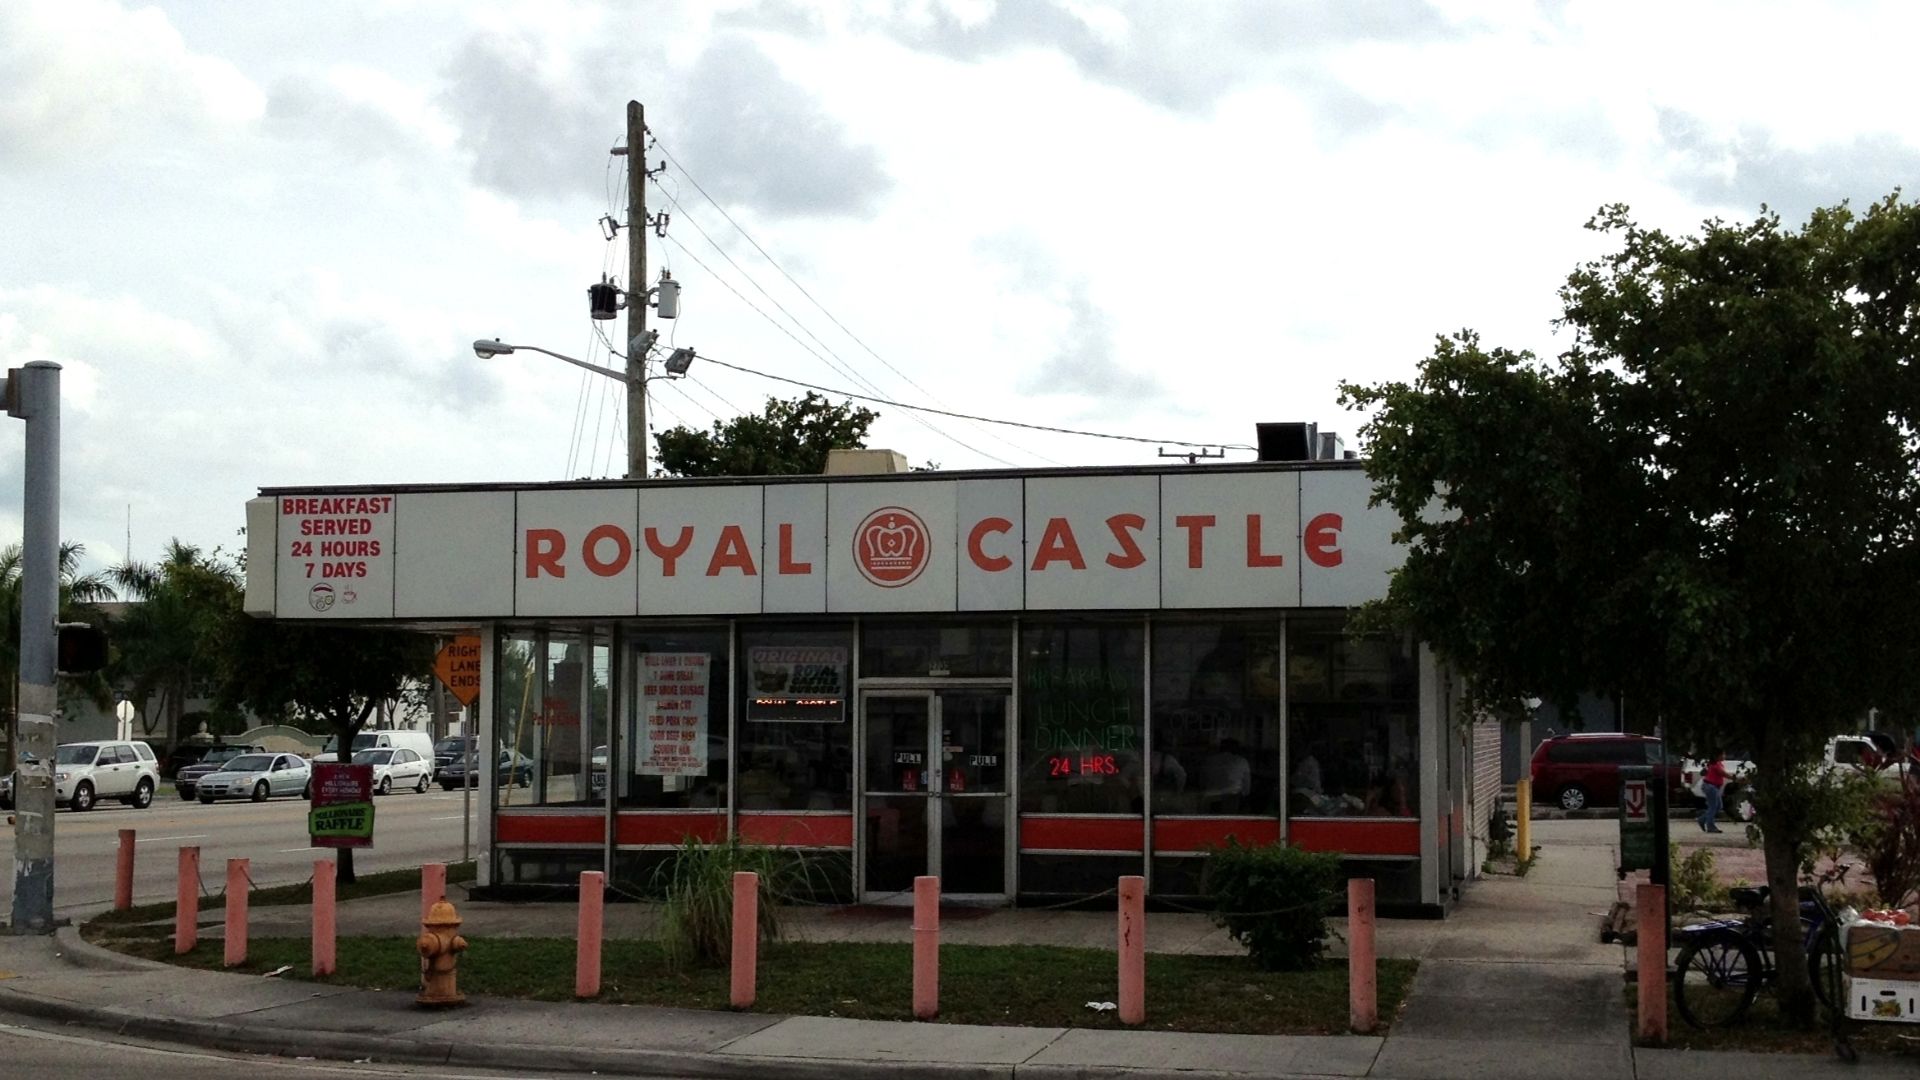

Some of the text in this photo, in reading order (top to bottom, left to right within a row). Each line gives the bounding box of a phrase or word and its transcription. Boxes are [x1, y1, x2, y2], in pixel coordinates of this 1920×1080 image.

[282, 497, 392, 515] BREAKFAST
[300, 518, 372, 535] SERVED
[291, 540, 381, 557] 24 HOURS
[526, 512, 1343, 578] ROYAL CASTLE
[304, 561, 367, 578] 7 DAYS
[793, 664, 839, 677] ROYAL
[1038, 695, 1131, 725] LUNCH
[1033, 725, 1136, 752] DINNER
[894, 752, 922, 764] PULL
[970, 755, 998, 767] PULL
[1049, 754, 1120, 776] 24 HRS.
[315, 818, 366, 831] RAFFLE
